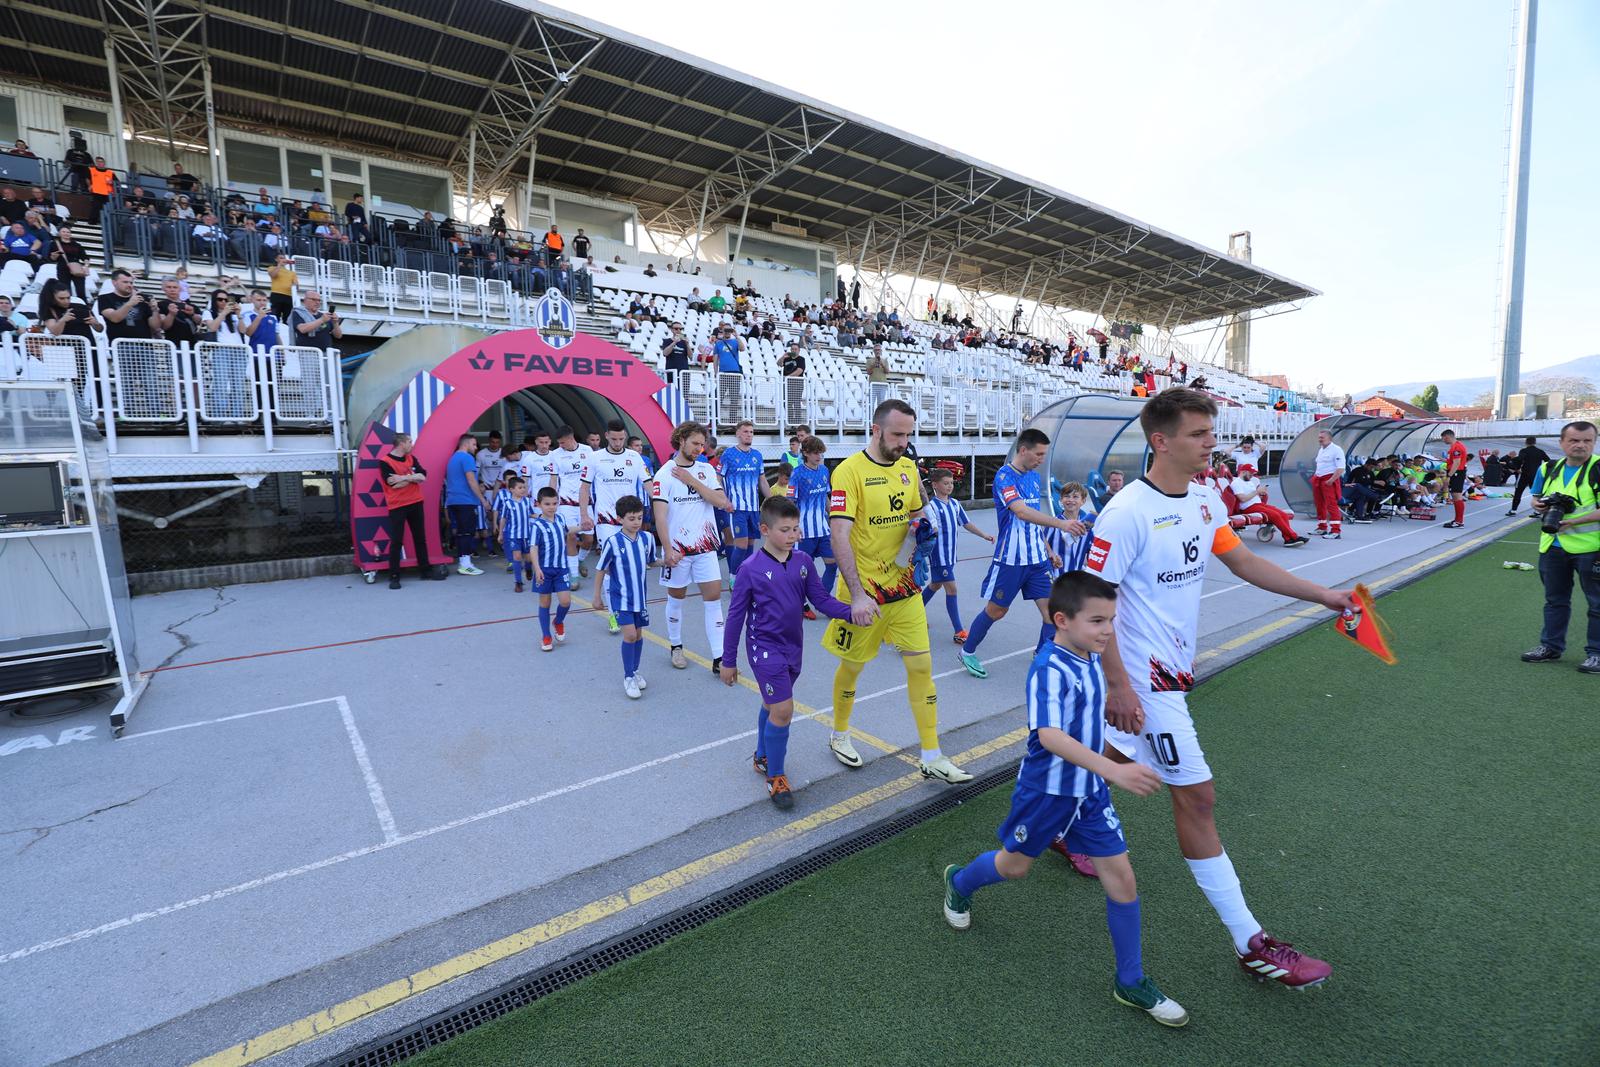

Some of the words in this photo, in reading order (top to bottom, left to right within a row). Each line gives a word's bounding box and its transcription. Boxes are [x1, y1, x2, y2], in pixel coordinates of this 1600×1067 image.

[503, 352, 634, 378] FAVBET
[1153, 513, 1182, 525] ADMIRAL
[835, 626, 853, 650] 31
[1145, 732, 1180, 766] 10
